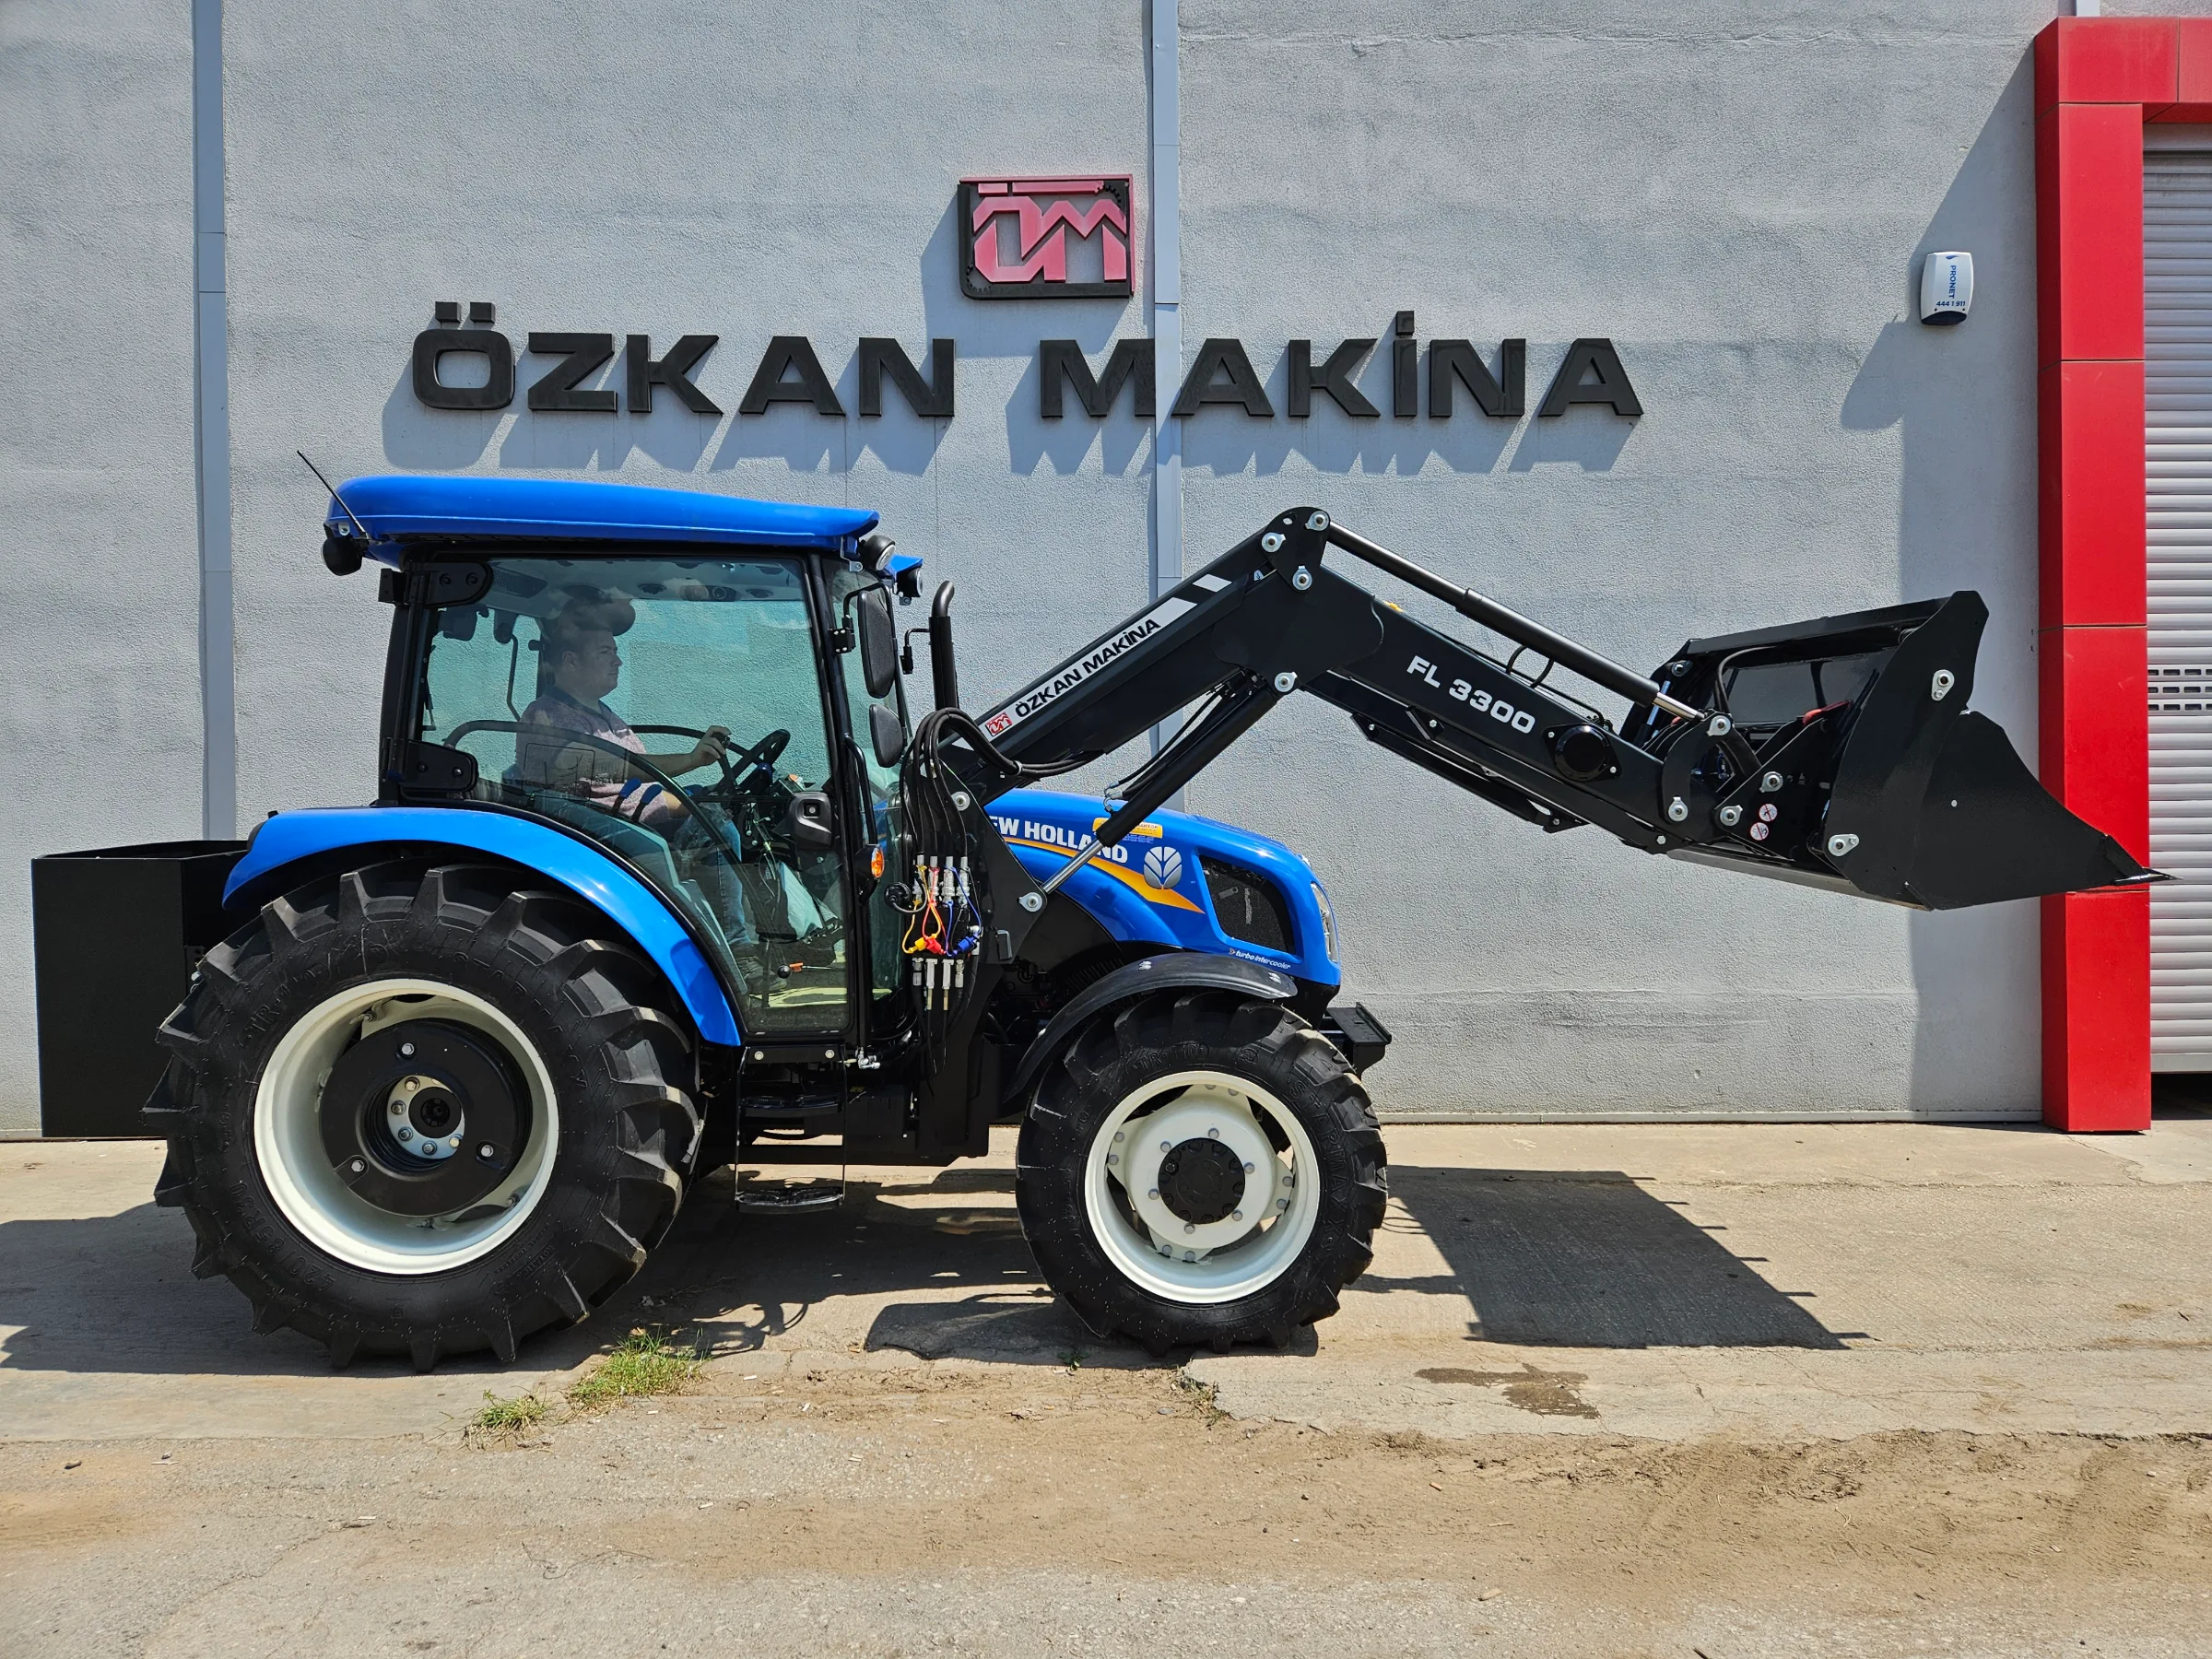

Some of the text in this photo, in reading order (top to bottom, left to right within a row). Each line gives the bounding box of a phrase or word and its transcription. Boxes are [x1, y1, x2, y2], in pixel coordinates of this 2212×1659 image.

[1948, 265, 1957, 299] PRONET
[412, 300, 1643, 418] ÖZKAN MAKİNA
[1015, 618, 1161, 718] ÖZKAN MAKİNA
[1406, 654, 1536, 734] FL 3300
[1235, 949, 1291, 970] turbo intercooler
[229, 1182, 336, 1291] 420/85R30
